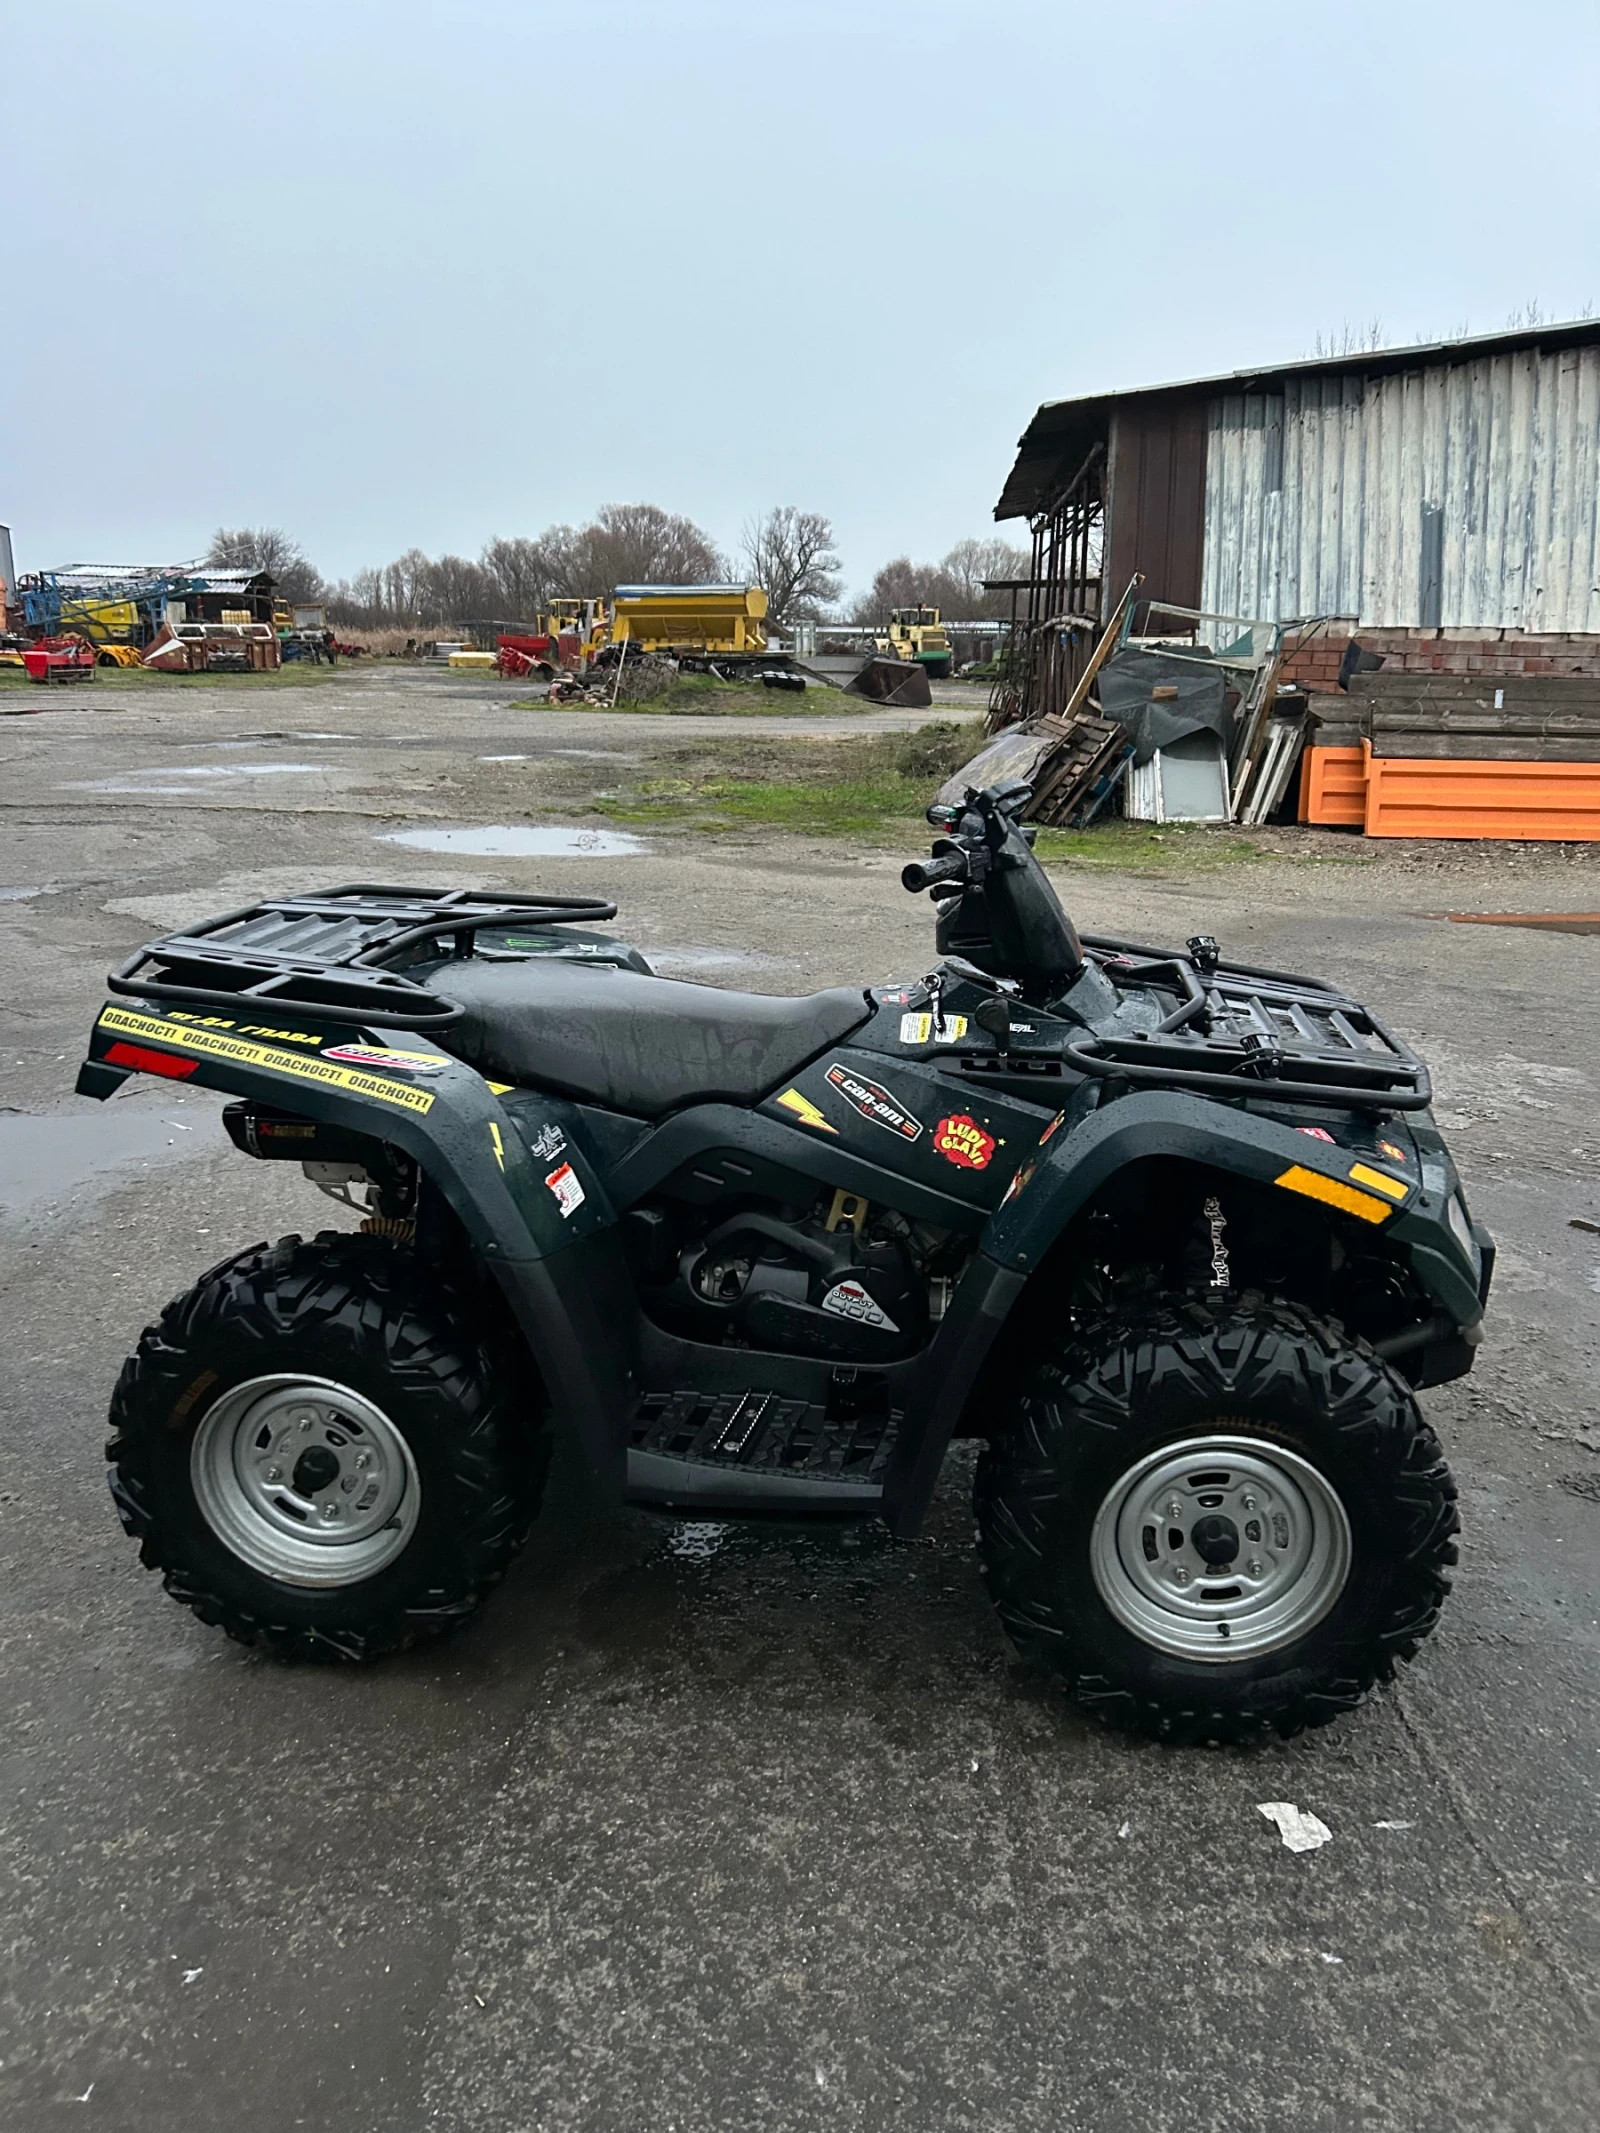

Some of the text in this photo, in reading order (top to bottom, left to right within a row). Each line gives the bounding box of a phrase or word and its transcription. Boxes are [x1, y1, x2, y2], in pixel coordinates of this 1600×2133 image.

[104, 1011, 429, 1108] ОПАСНОСТ! ОПАСНОСТ! ОПАСНОСТ! ОПАСНОСТ!
[841, 1079, 905, 1127] can-am
[947, 1120, 986, 1148] LUDI
[941, 1137, 985, 1165] GLAVI
[827, 1297, 884, 1325] 400
[832, 1290, 874, 1308] OUTPUT
